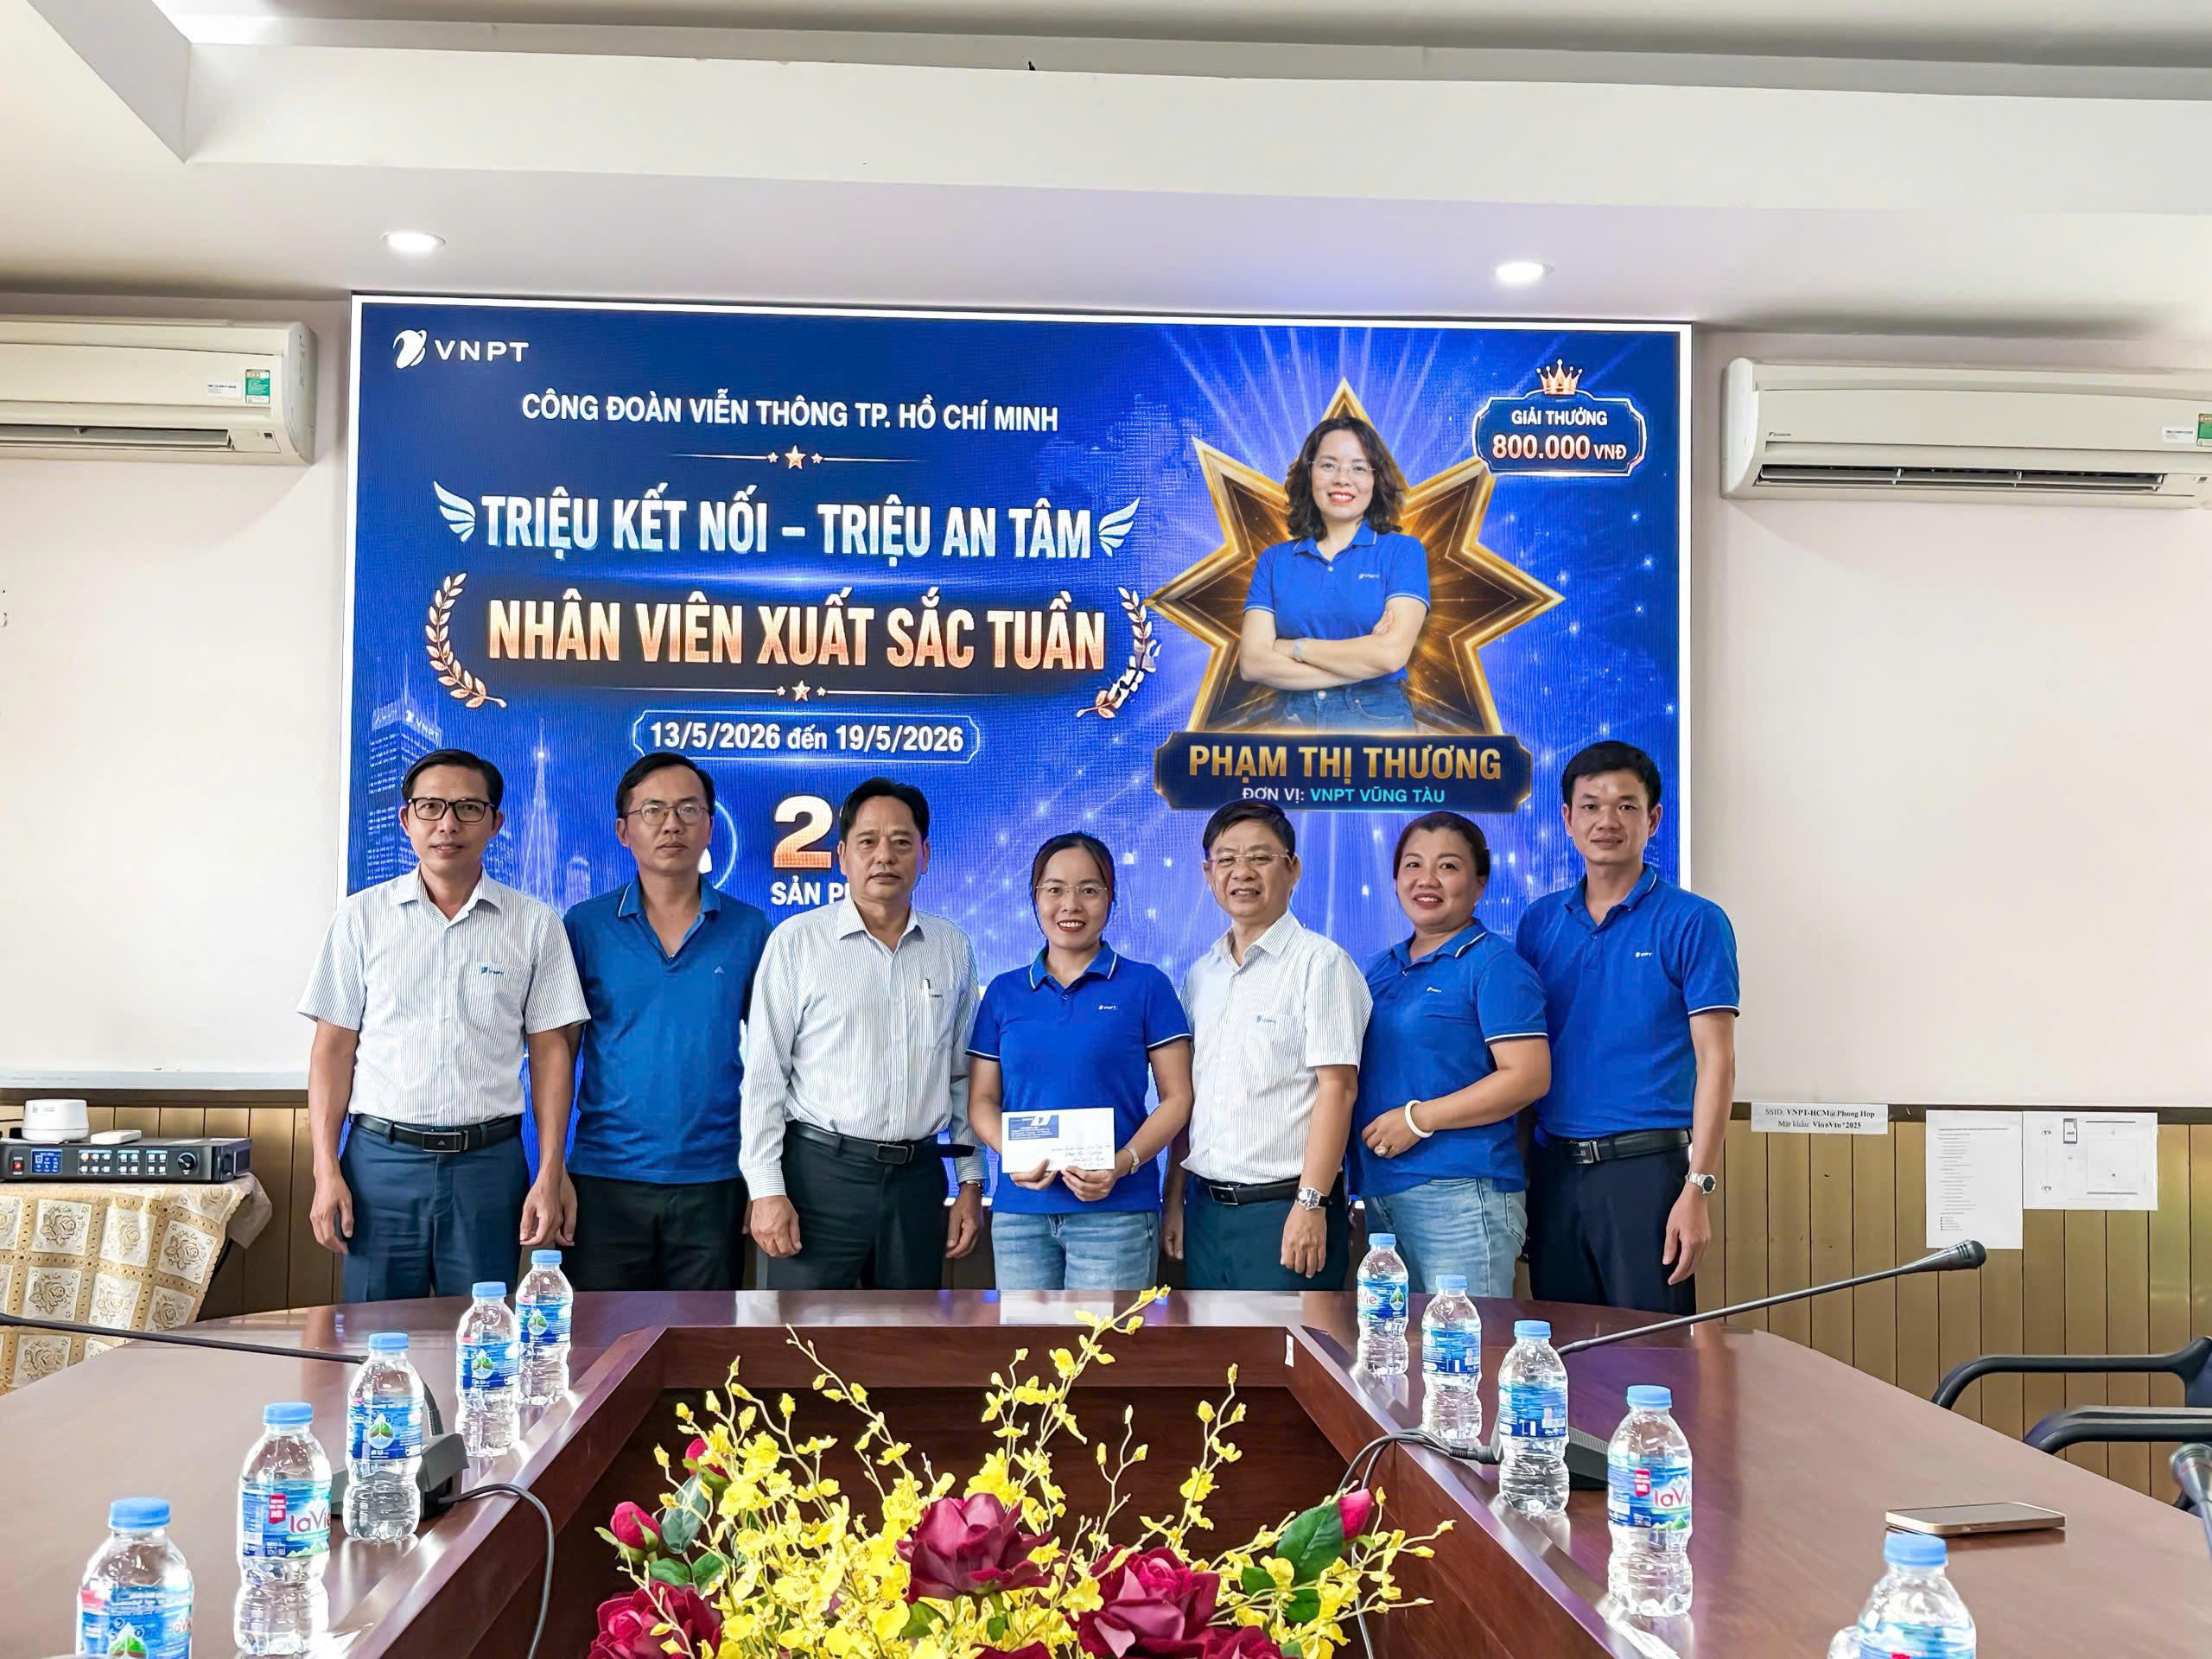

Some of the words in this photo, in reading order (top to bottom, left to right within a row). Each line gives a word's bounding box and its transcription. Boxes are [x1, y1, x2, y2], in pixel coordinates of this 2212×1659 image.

[434, 340, 529, 363] VNPT
[522, 388, 599, 421] CÔNG
[607, 391, 682, 423] ĐOÀN
[690, 388, 748, 424] VIỄN
[756, 395, 848, 427] THÔNG
[855, 403, 891, 428] TP.
[899, 393, 937, 429] HỒ
[944, 399, 988, 431] CHÍ
[995, 406, 1058, 432] MINH
[1511, 406, 1542, 425] GIẢI
[1545, 406, 1608, 426] THƯỞNG
[1492, 434, 1591, 460] 800.000
[1594, 444, 1627, 460] VNĐ
[481, 486, 599, 561] TRIỆU
[613, 482, 687, 552] KẾT
[699, 484, 767, 554] NỐI
[817, 493, 931, 567] TRIỆU
[942, 507, 996, 557] AN
[1008, 497, 1091, 559] TÂM
[488, 588, 620, 661] NHÂN
[635, 590, 743, 664] VIÊN
[756, 586, 874, 666] XUẤT
[886, 586, 976, 669] SẮC
[987, 590, 1105, 671] TUẦN
[650, 721, 780, 750] 13/5/2026
[787, 722, 827, 751] đến
[836, 725, 964, 753] 19/5/2026
[1189, 744, 1287, 784] PHẠM
[1299, 747, 1352, 785] THỊ
[1363, 744, 1502, 780] THƯƠNG
[1242, 787, 1279, 802] ĐƠN
[1284, 787, 1305, 804] VỊ:
[1310, 788, 1356, 802] VNPT
[1359, 786, 1408, 803] VŨNG
[1412, 787, 1446, 803] TÀU
[774, 795, 845, 869] 2
[771, 875, 821, 906] SẢN
